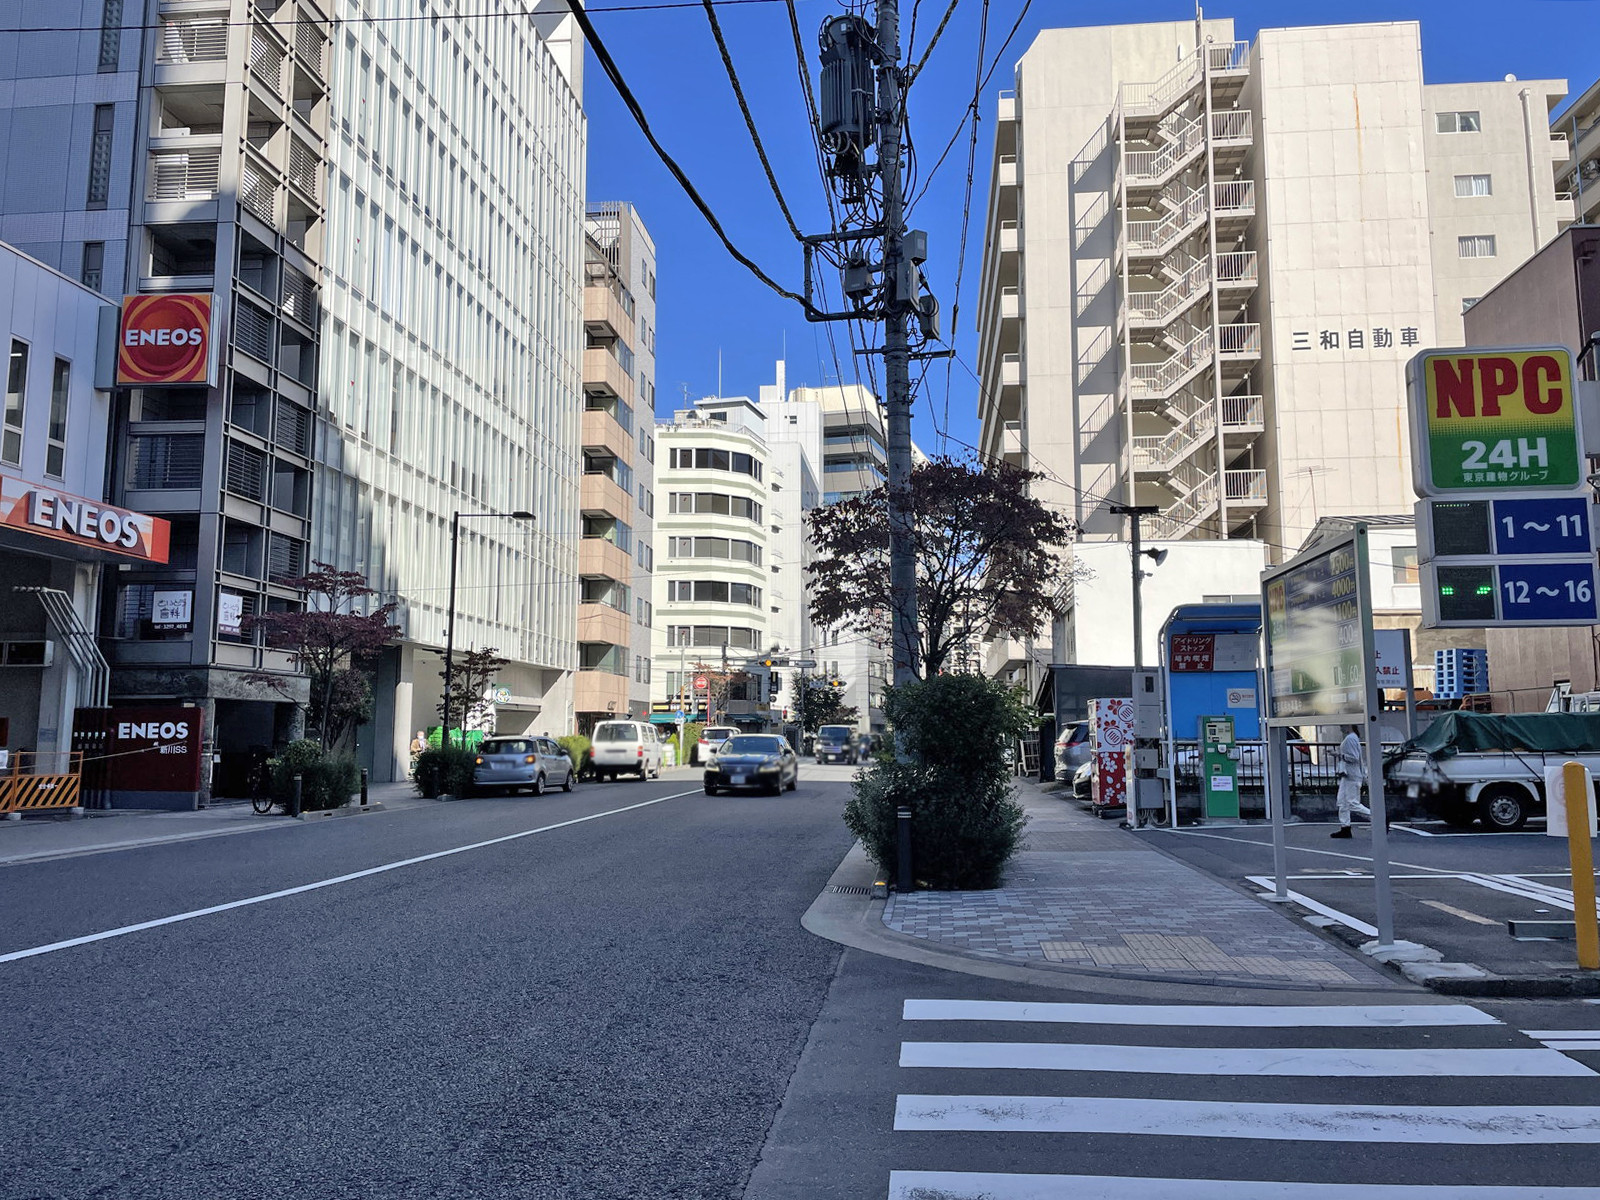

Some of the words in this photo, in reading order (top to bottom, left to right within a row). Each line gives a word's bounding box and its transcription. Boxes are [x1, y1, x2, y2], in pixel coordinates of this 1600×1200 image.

[125, 328, 202, 346] ENEOS
[1292, 327, 1420, 351] 三和自動車
[1433, 356, 1563, 418] NPC
[1461, 437, 1548, 470] 24H
[1463, 470, 1548, 483] 東京建物グループ
[28, 491, 138, 548] ENEOS
[1174, 637, 1211, 645] アイドリング
[118, 722, 189, 739] ENEOS
